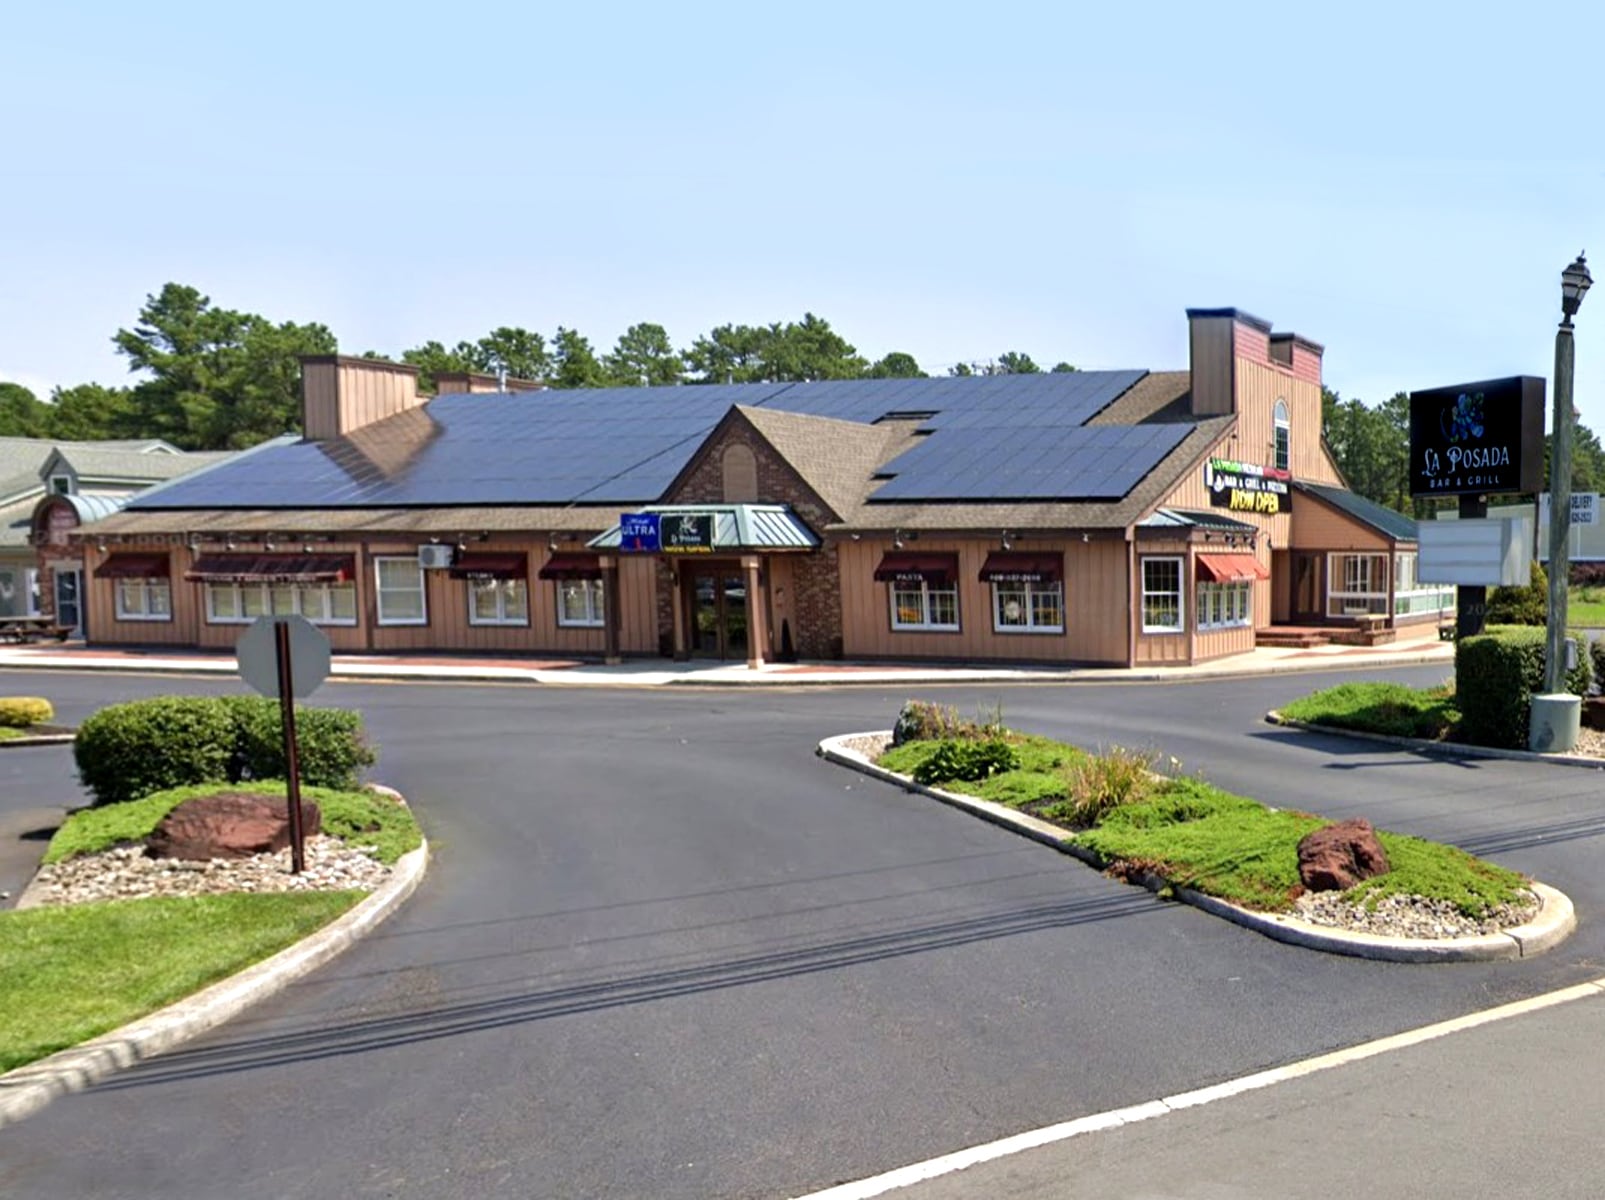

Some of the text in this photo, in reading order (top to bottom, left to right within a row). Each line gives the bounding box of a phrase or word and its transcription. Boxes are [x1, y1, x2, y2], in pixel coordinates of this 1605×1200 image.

[1446, 446, 1510, 474] POSADA
[1429, 477, 1451, 488] BAR
[1467, 474, 1500, 486] GRILL
[1230, 489, 1279, 514] NOW OPEN
[622, 525, 656, 536] ULTRA
[896, 573, 923, 581] PASTA
